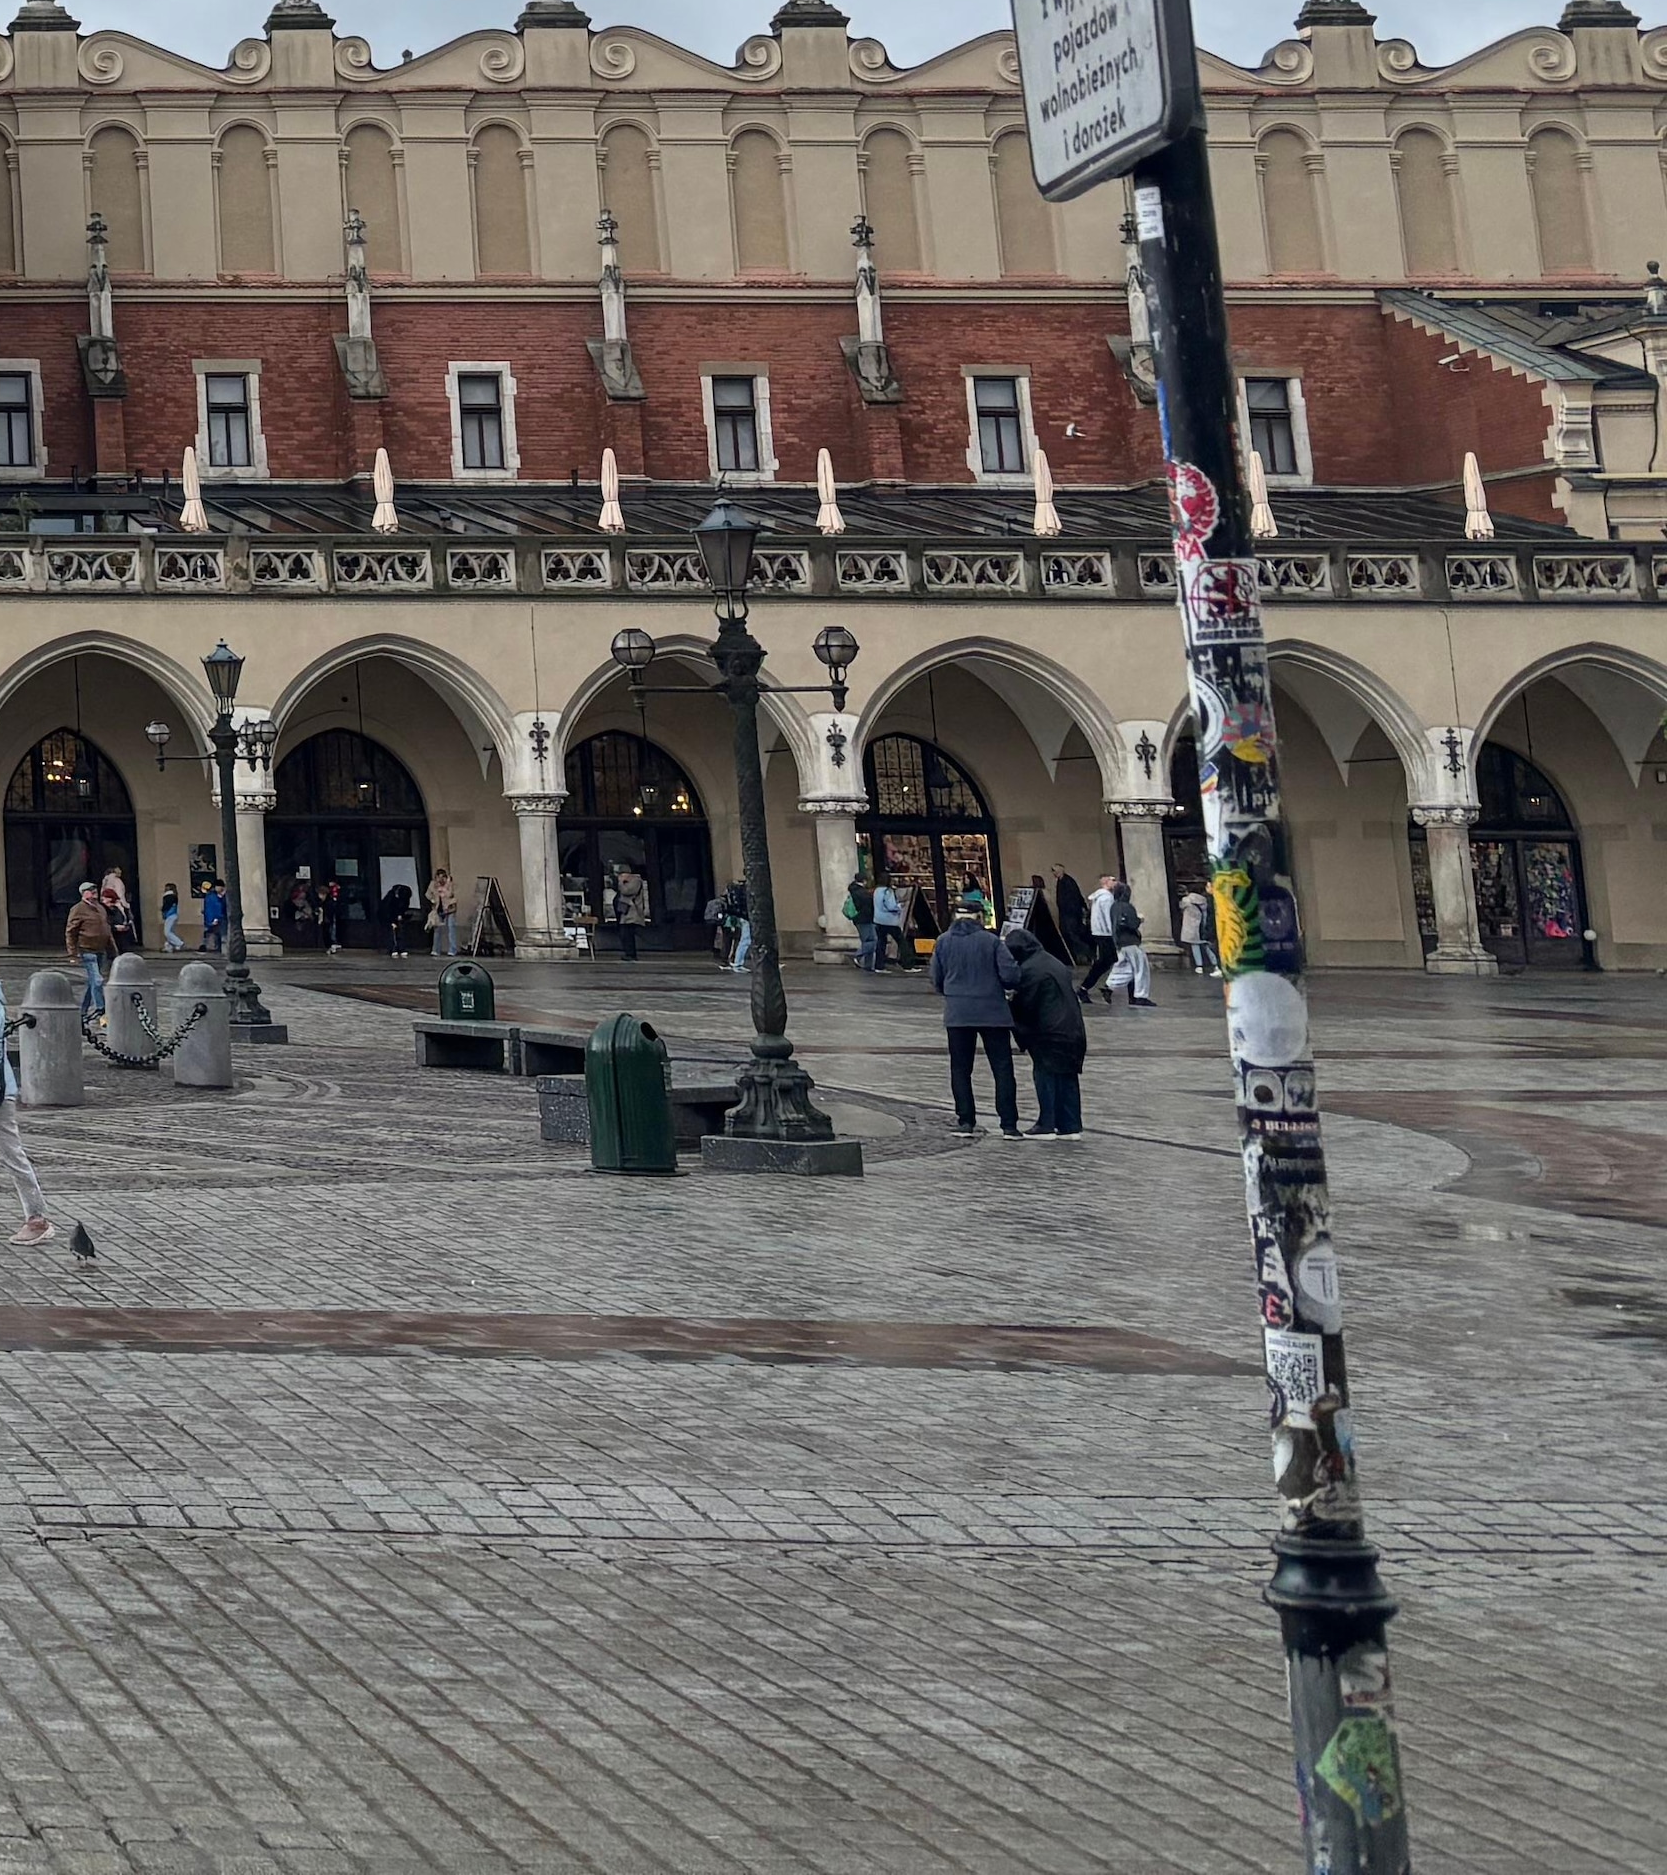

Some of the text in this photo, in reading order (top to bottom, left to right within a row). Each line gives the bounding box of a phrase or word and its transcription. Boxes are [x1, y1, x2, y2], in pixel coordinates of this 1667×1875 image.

[1040, 37, 1138, 123] wolnobieżnych
[1063, 97, 1126, 160] i dorożek
